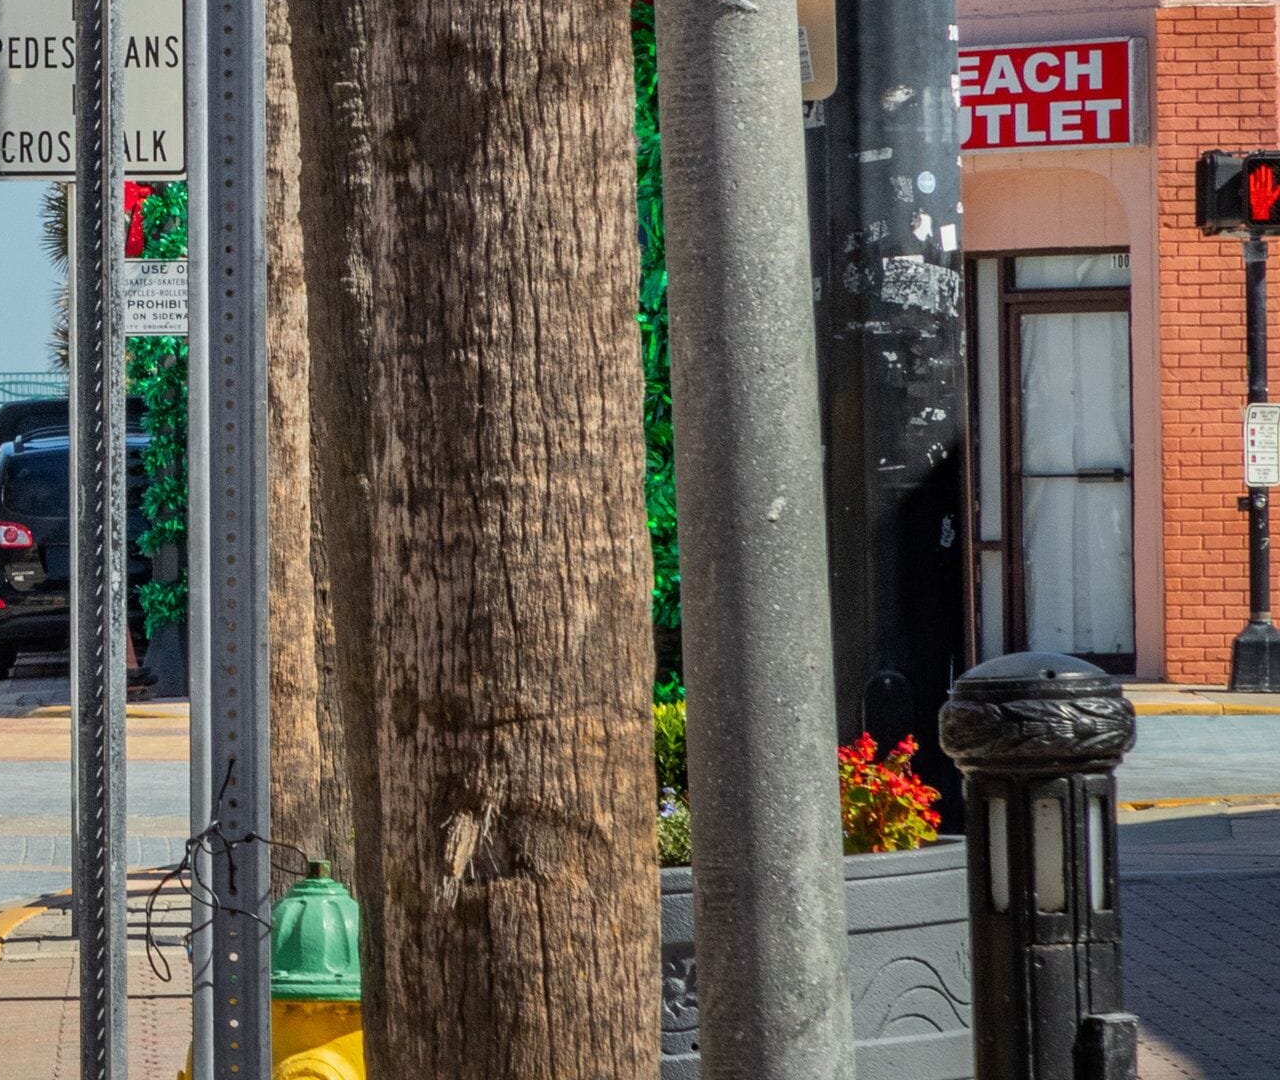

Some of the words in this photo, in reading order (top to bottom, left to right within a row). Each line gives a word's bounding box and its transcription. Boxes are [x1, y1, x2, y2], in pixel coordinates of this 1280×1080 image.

[957, 49, 1103, 96] EACH
[1112, 254, 1130, 268] 100
[141, 264, 168, 275] USE
[176, 264, 188, 275] O
[127, 299, 188, 309] PROHIBIT
[133, 313, 147, 321] ON
